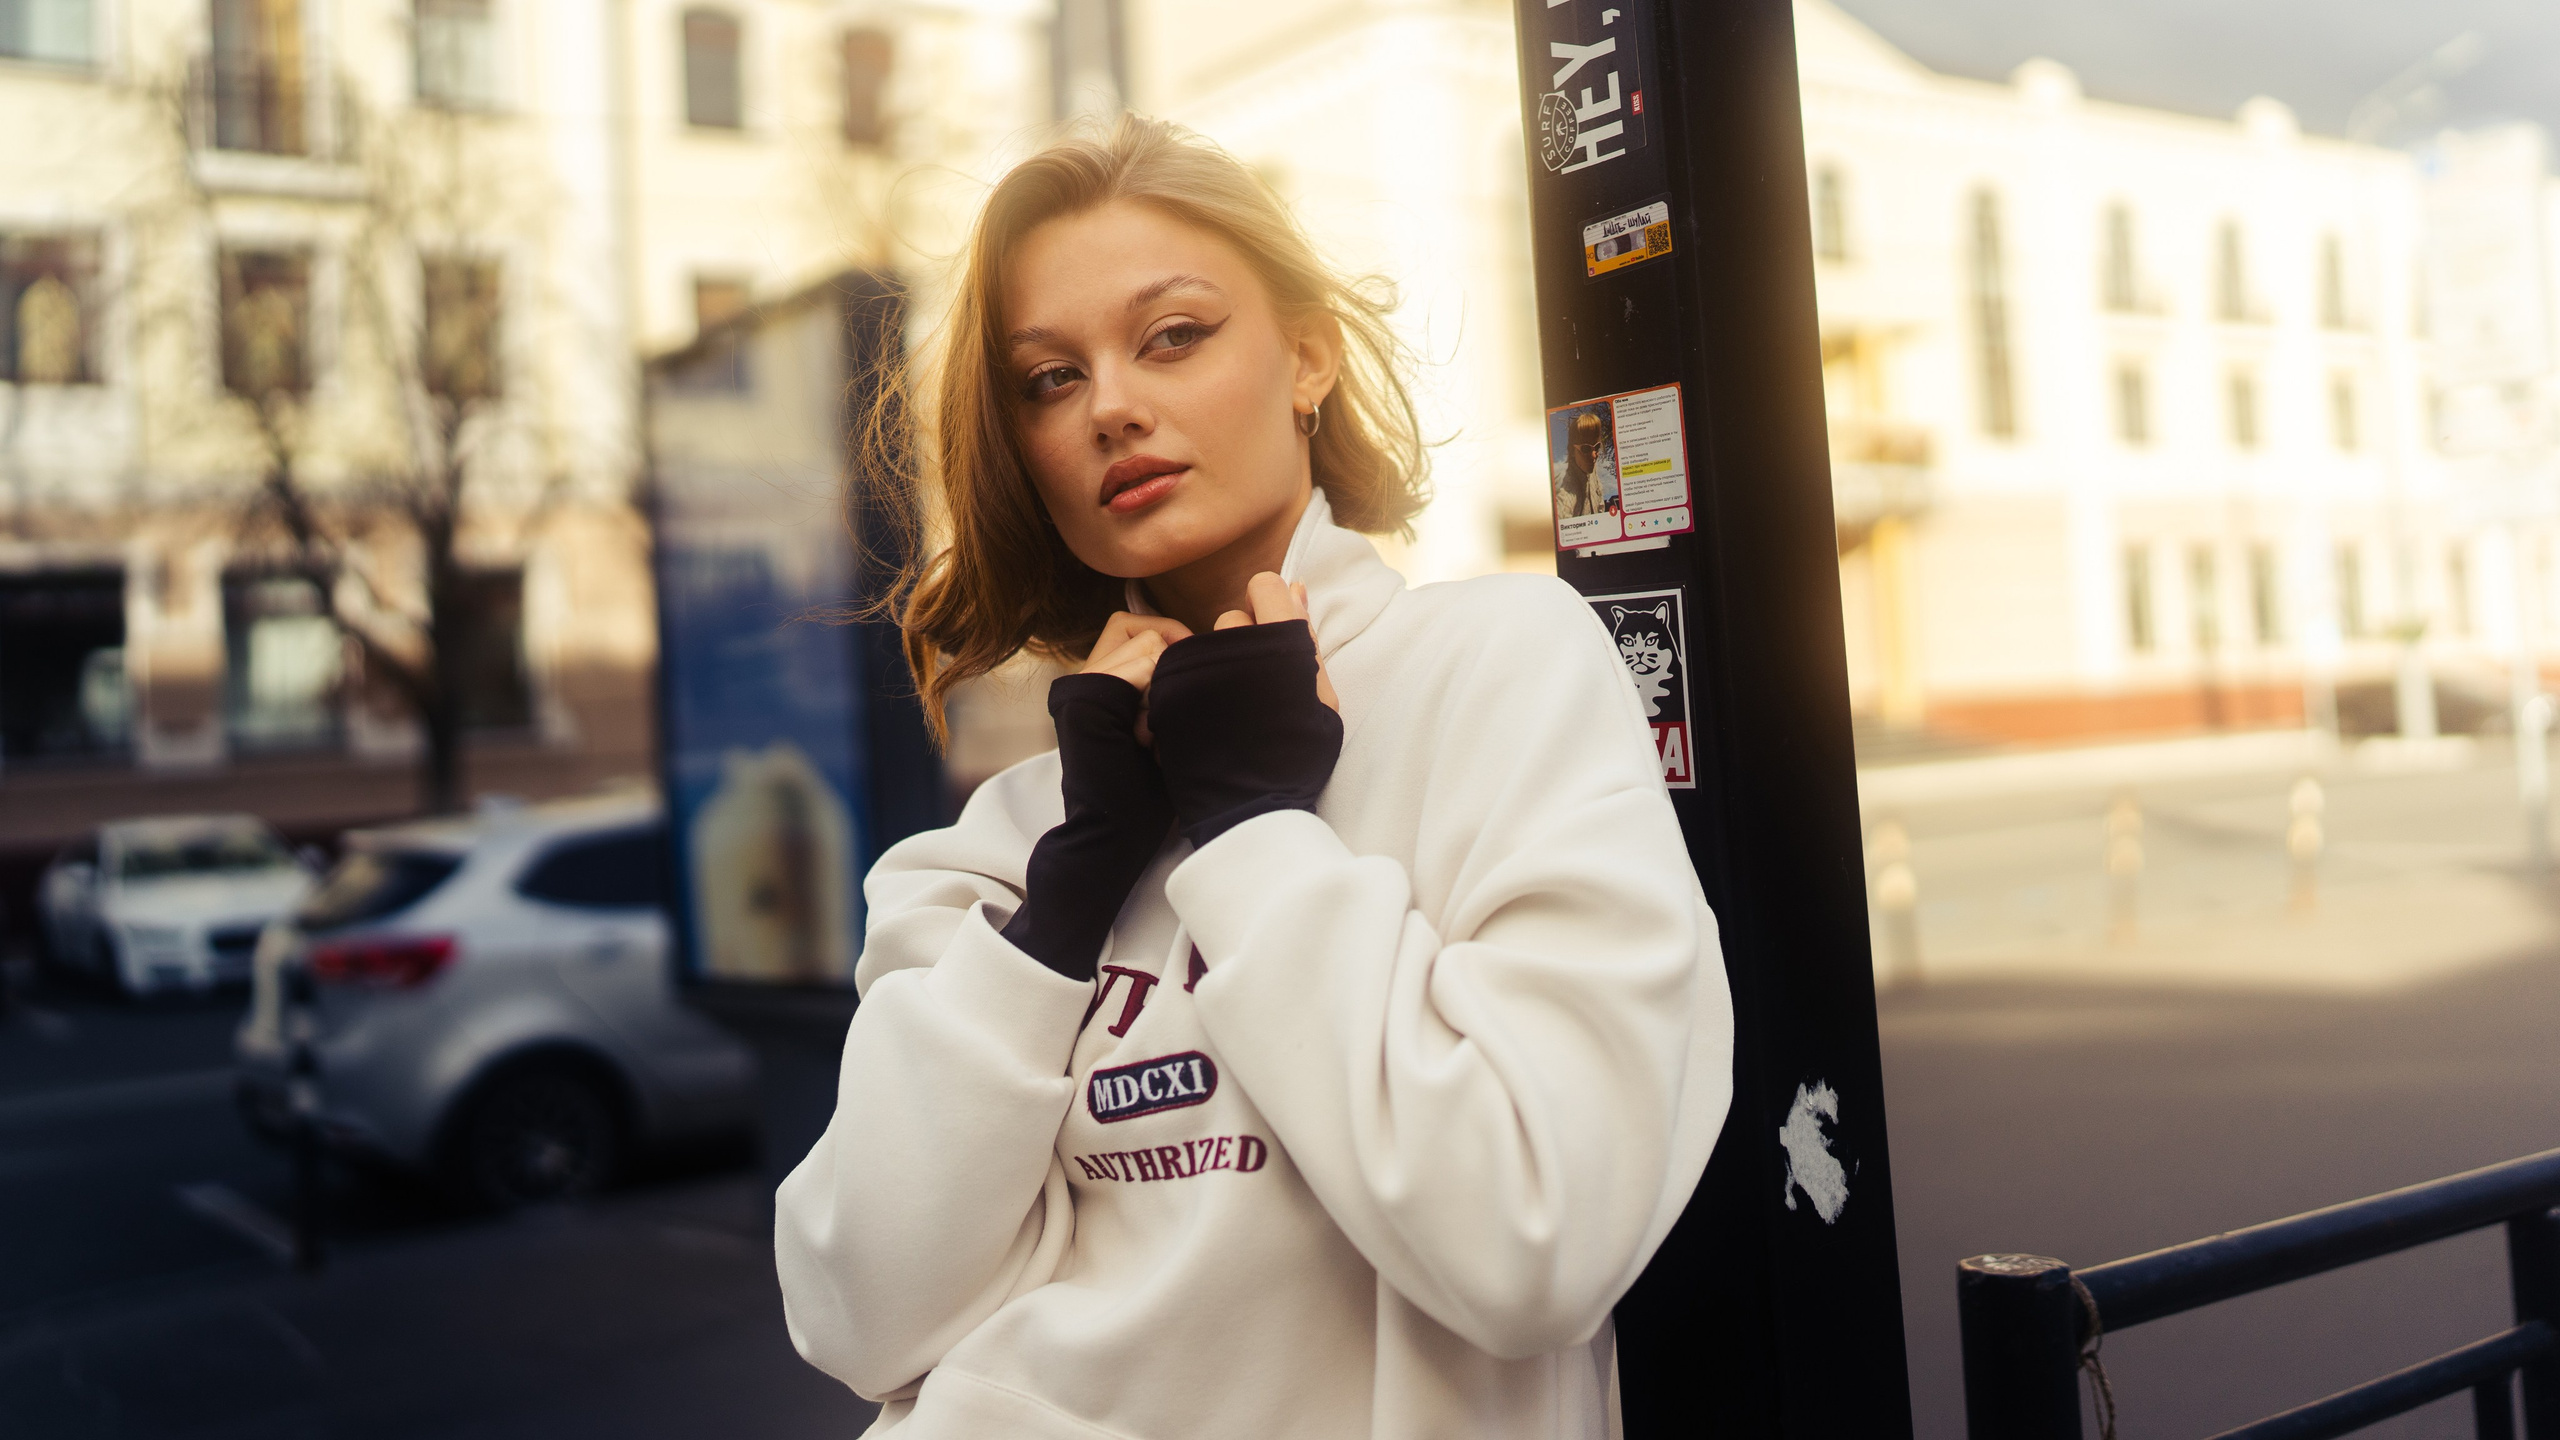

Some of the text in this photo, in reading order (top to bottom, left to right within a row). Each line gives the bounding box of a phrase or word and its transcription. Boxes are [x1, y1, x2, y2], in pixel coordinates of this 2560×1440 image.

[1541, 104, 1556, 161] SURF
[1560, 101, 1575, 153] COFFEE
[1560, 521, 1587, 531] Виктория
[1093, 1058, 1209, 1114] MDCXI
[1074, 1135, 1268, 1183] AUTHRIZED
